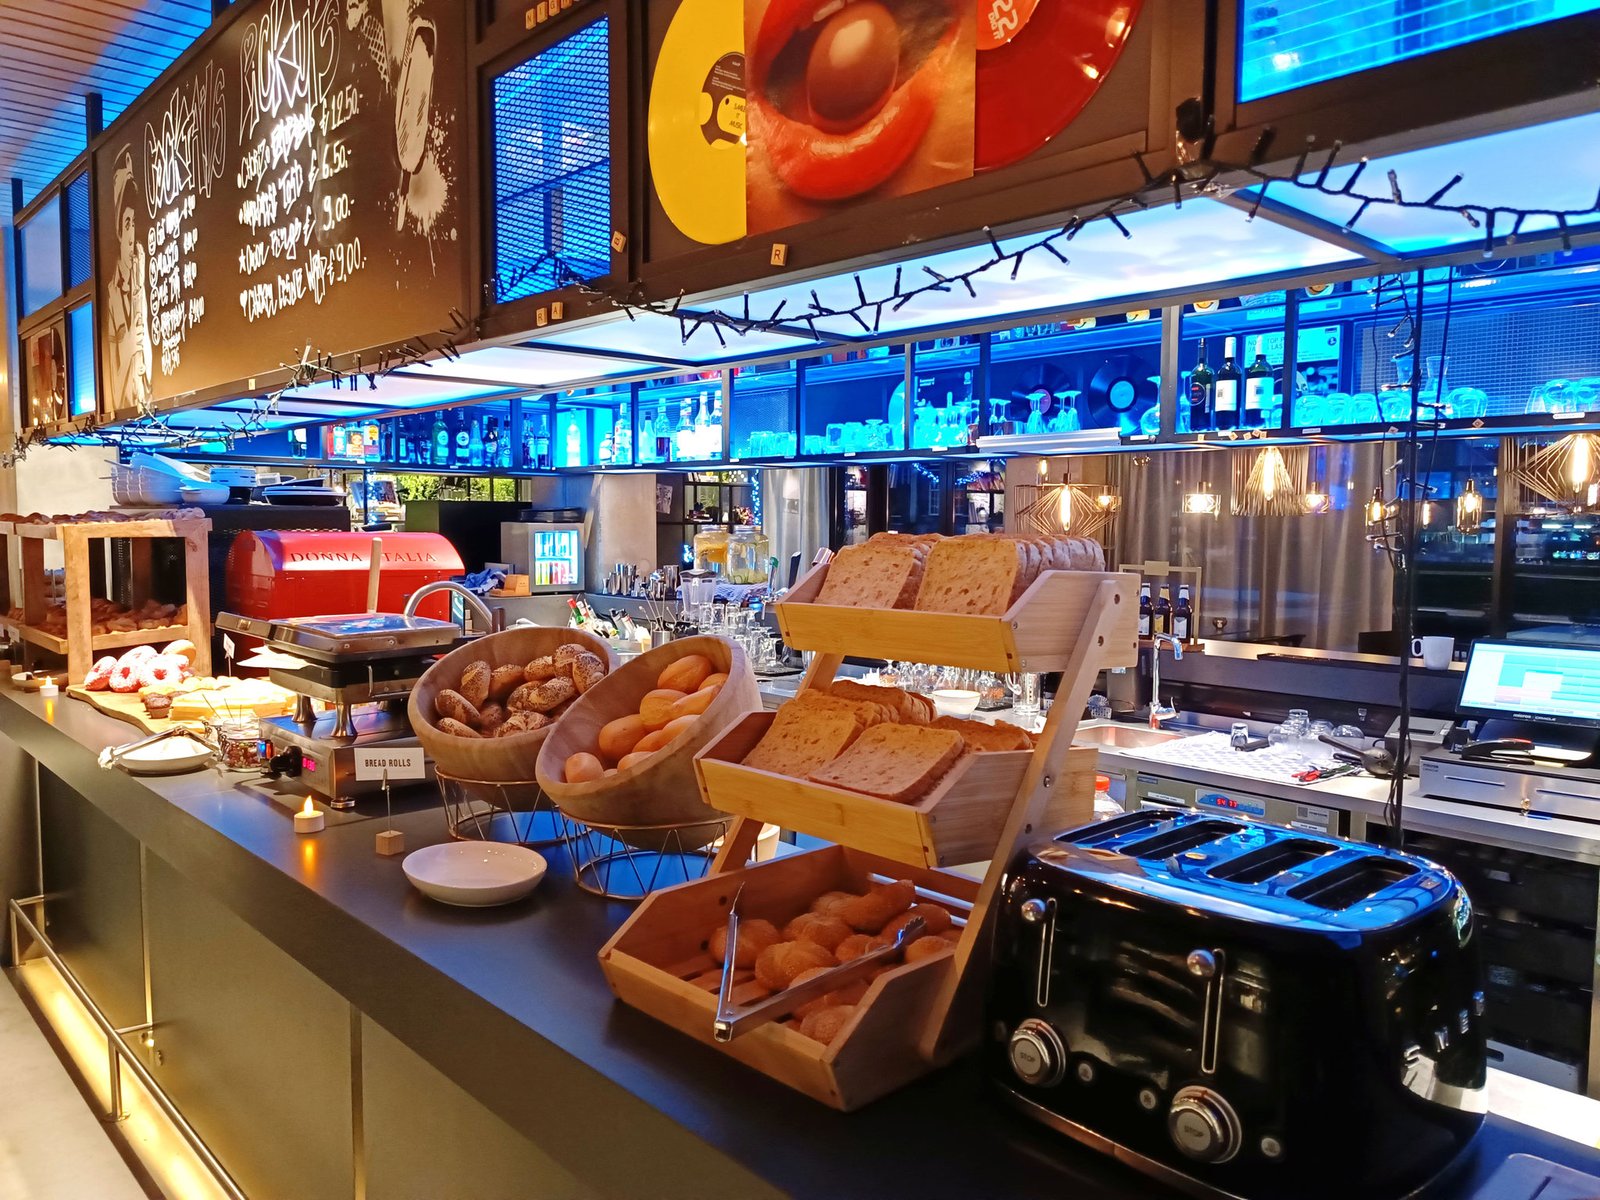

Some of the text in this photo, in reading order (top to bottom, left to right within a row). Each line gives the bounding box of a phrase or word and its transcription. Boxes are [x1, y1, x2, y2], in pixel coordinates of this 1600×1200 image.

[290, 551, 437, 563] DONNA TALIA
[364, 758, 411, 768] BREAD ROLLS
